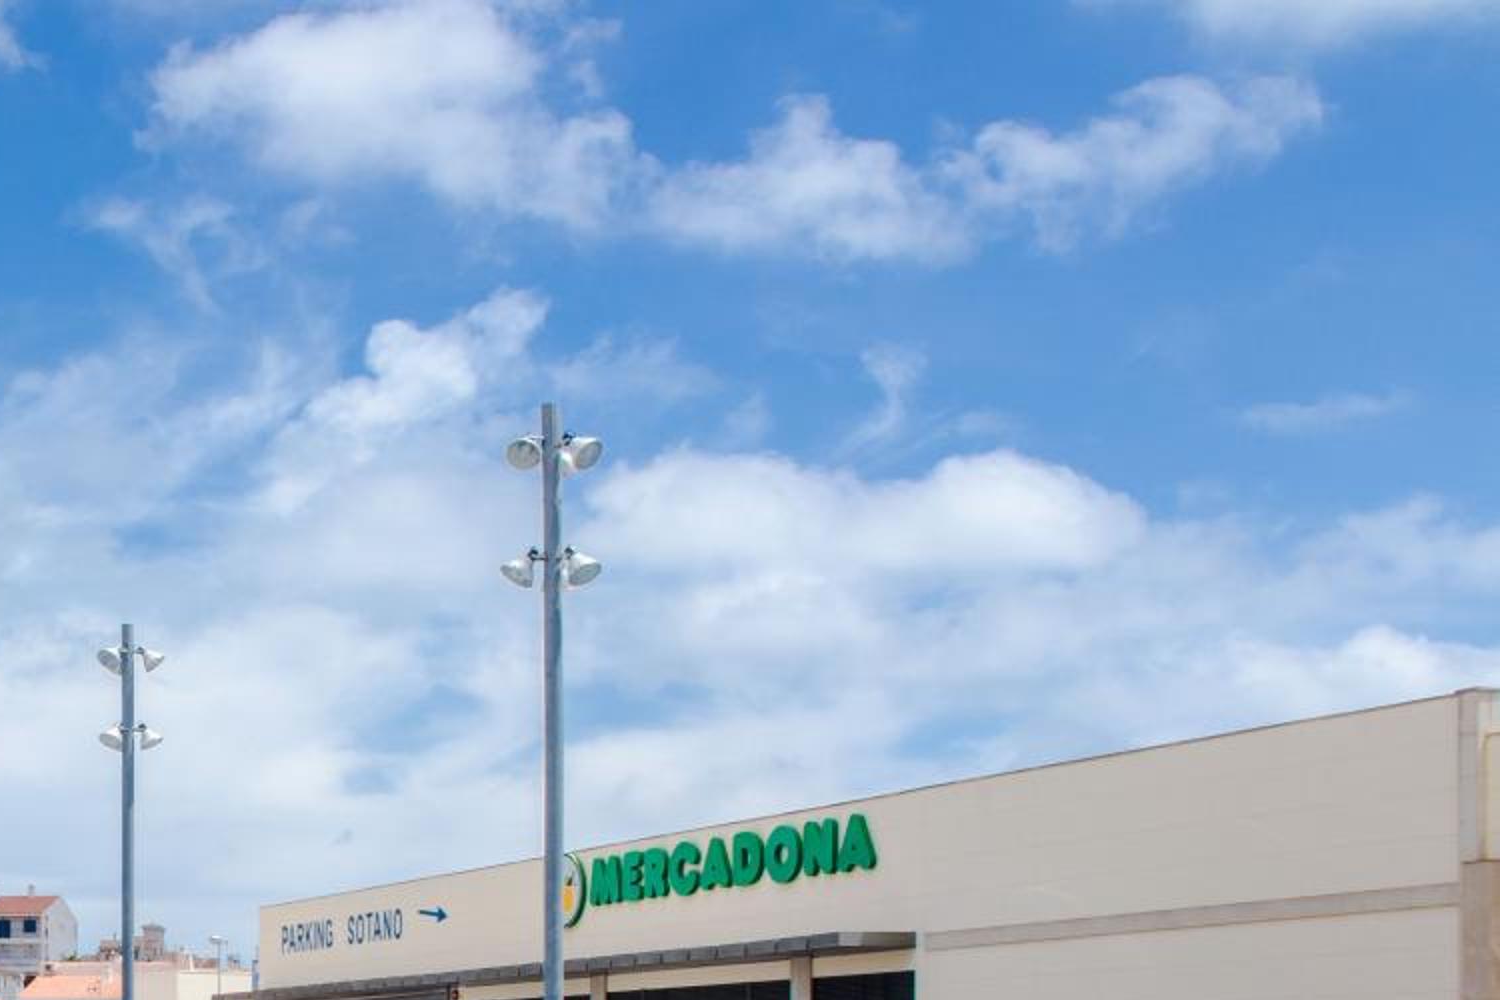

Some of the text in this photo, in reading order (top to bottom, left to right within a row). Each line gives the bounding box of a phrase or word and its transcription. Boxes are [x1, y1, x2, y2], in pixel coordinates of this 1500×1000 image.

[590, 813, 877, 906] MERCADONA
[281, 908, 403, 953] PARKING SOTANO
